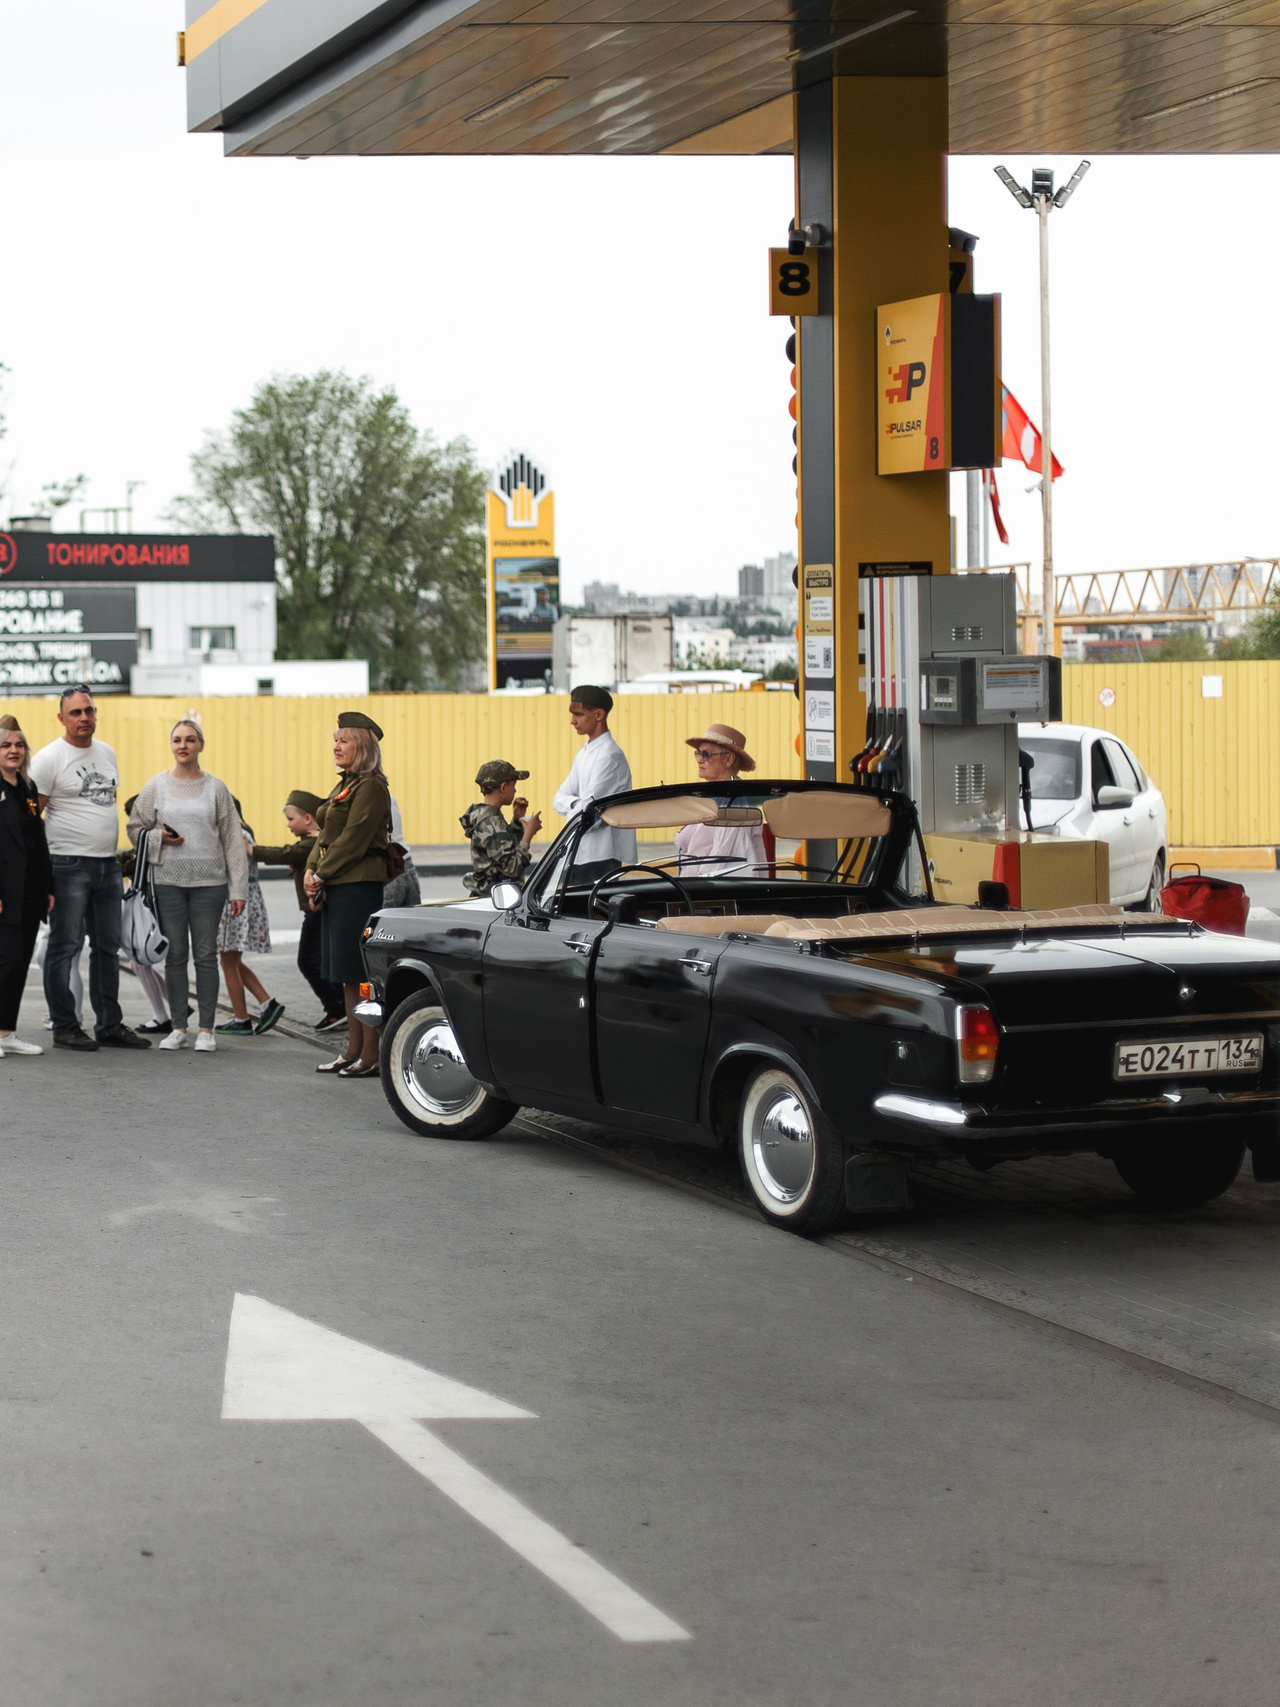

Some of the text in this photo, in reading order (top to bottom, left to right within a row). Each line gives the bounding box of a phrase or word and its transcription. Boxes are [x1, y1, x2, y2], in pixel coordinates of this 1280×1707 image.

[778, 261, 811, 296] 8
[950, 261, 967, 294] 7
[890, 420, 922, 433] PULSAR
[930, 436, 939, 460] 8
[46, 542, 190, 566] ТОНИРОВАНИЯ
[809, 579, 829, 587] БЫСТРО
[1221, 1039, 1255, 1060] 134
[1226, 1060, 1244, 1068] RUS
